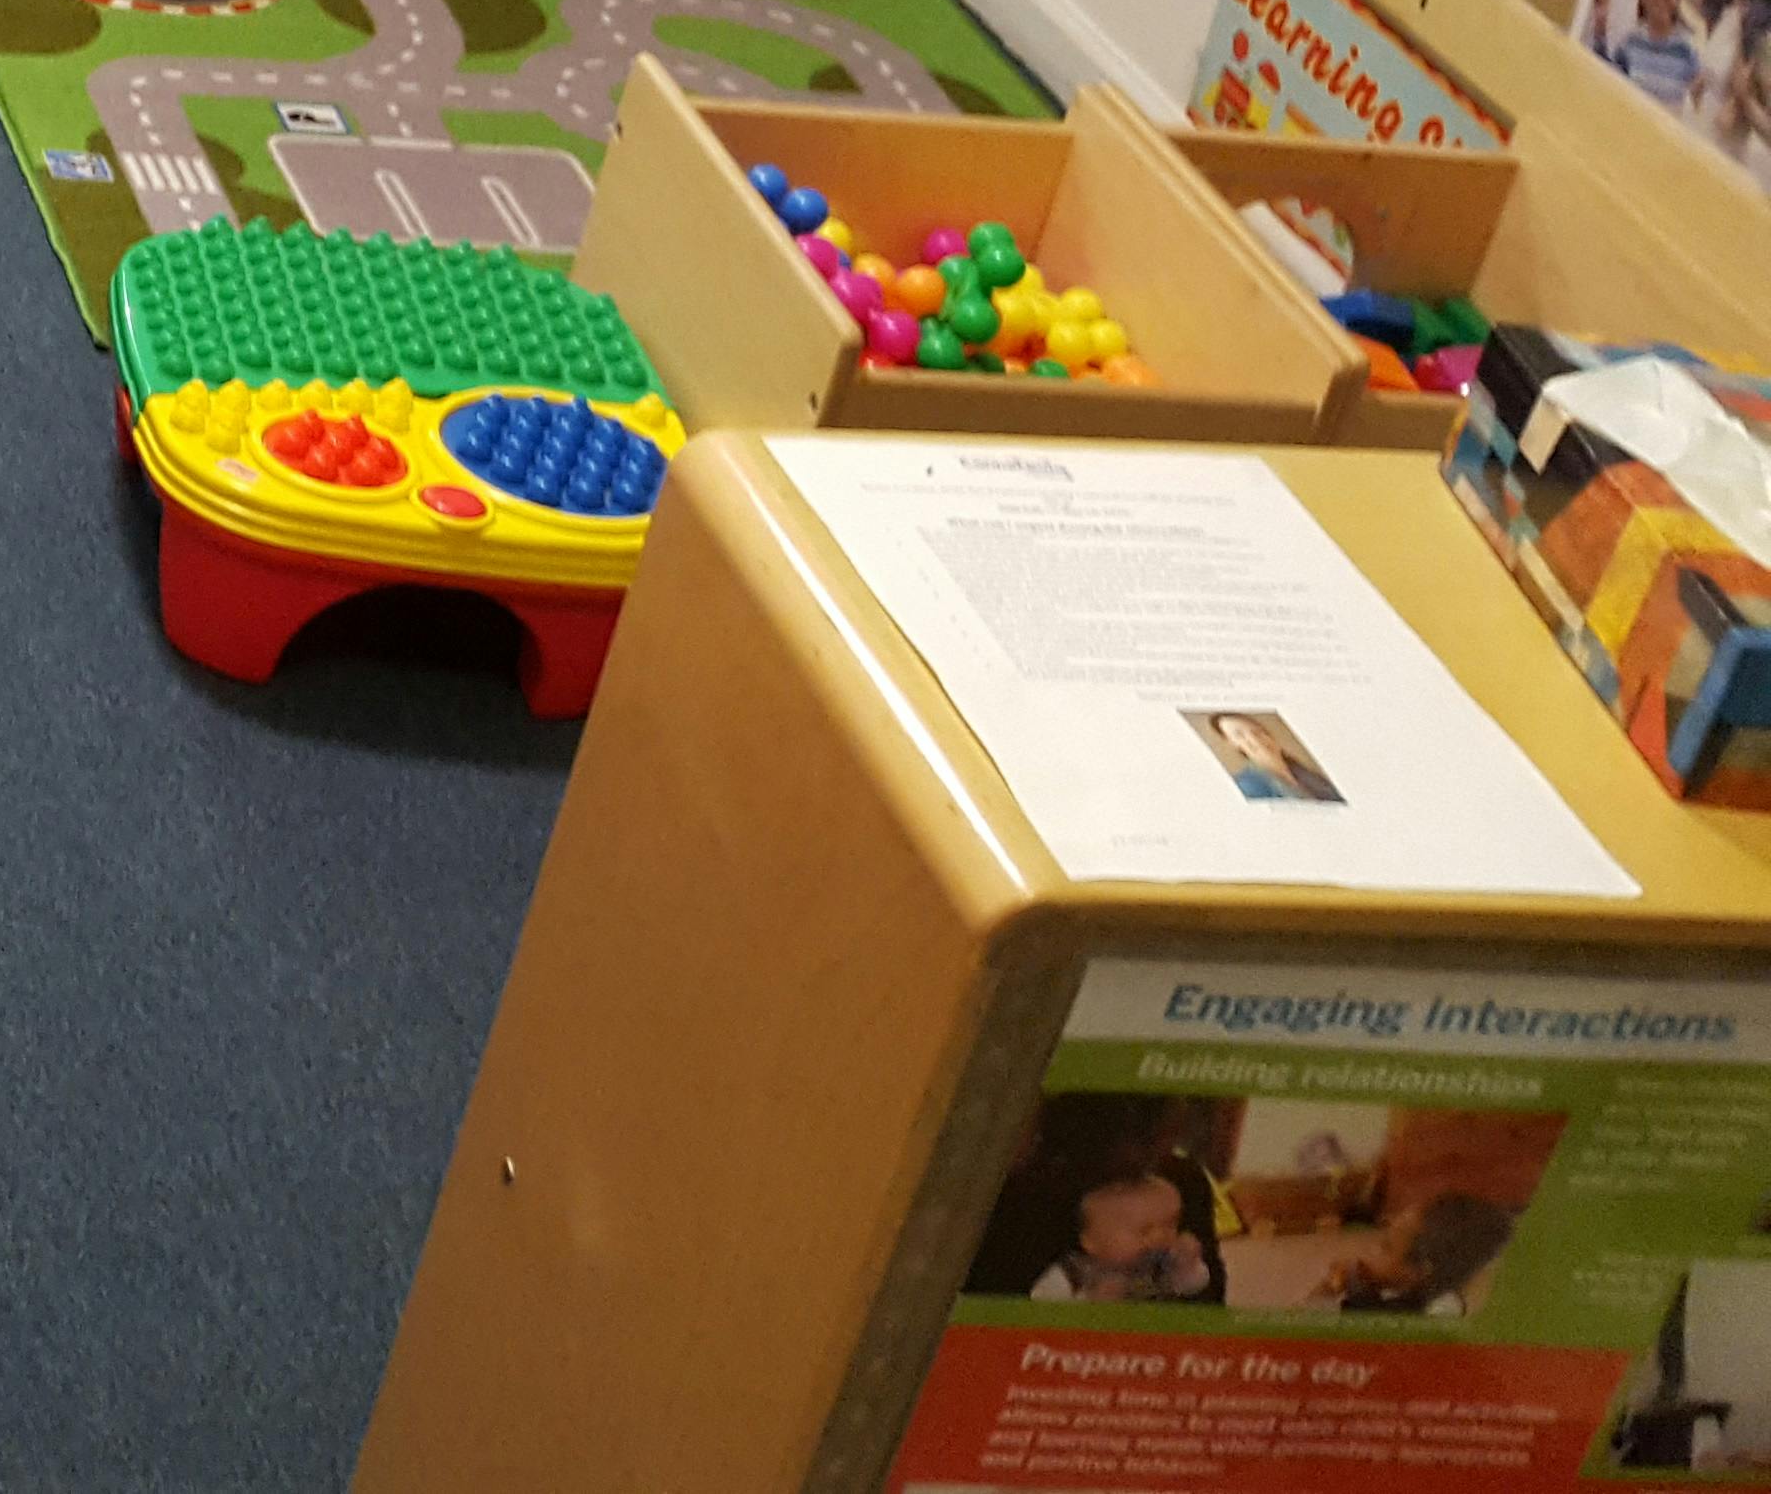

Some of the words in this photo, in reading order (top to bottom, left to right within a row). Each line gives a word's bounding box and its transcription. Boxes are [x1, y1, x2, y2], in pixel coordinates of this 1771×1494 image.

[1161, 981, 1413, 1040] Engaging
[1136, 1051, 1292, 1093] Building
[1300, 1059, 1544, 1104] relationships
[1019, 1341, 1168, 1381] Prepare
[1175, 1350, 1232, 1381] for
[1239, 1351, 1302, 1384] the
[1309, 1355, 1379, 1391] day
